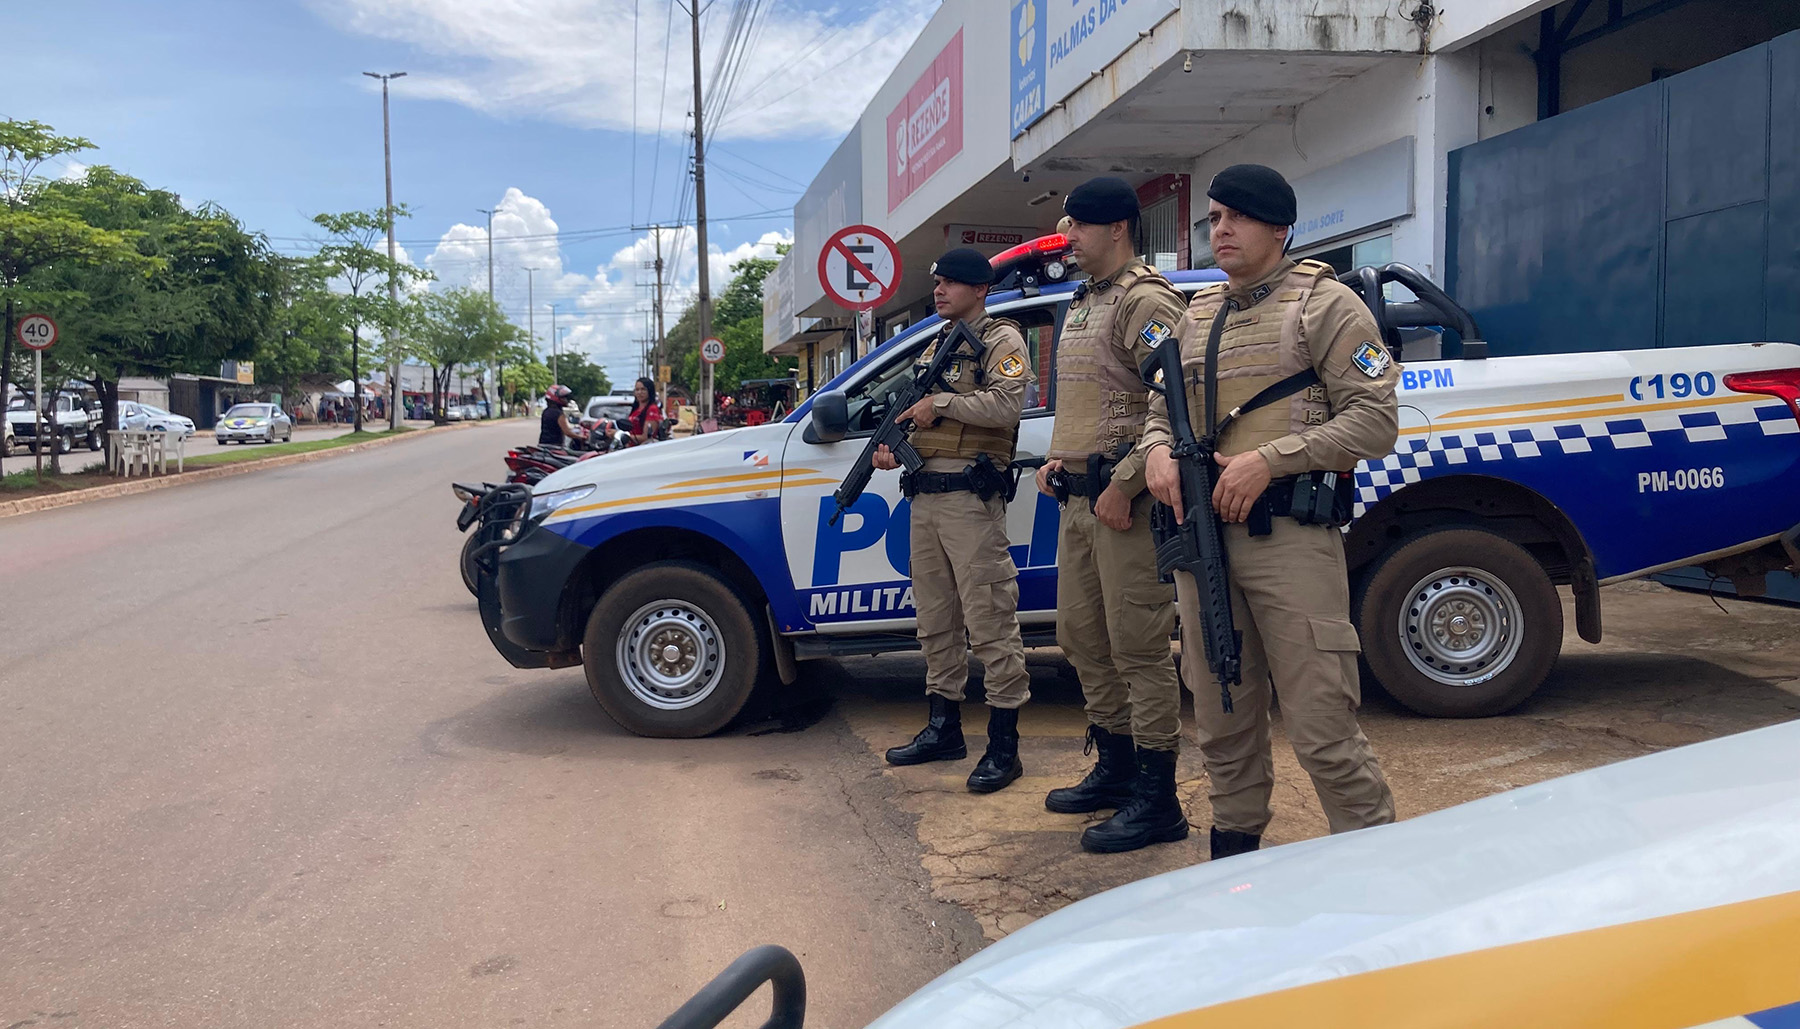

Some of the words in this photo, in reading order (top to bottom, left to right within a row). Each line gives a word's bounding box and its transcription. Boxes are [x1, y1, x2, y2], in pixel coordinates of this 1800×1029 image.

[1050, 6, 1096, 69] PALMAS
[910, 87, 947, 151] REZENDE
[1013, 84, 1041, 130] CAIXA
[1319, 208, 1345, 230] SORTE
[979, 233, 1021, 243] REZENDE
[846, 245, 874, 290] E
[24, 323, 49, 338] 40
[704, 343, 720, 354] 40
[1402, 368, 1455, 390] BPM
[1647, 371, 1716, 399] 190
[1638, 466, 1725, 493] PM-0066
[809, 587, 917, 616] MILITA
